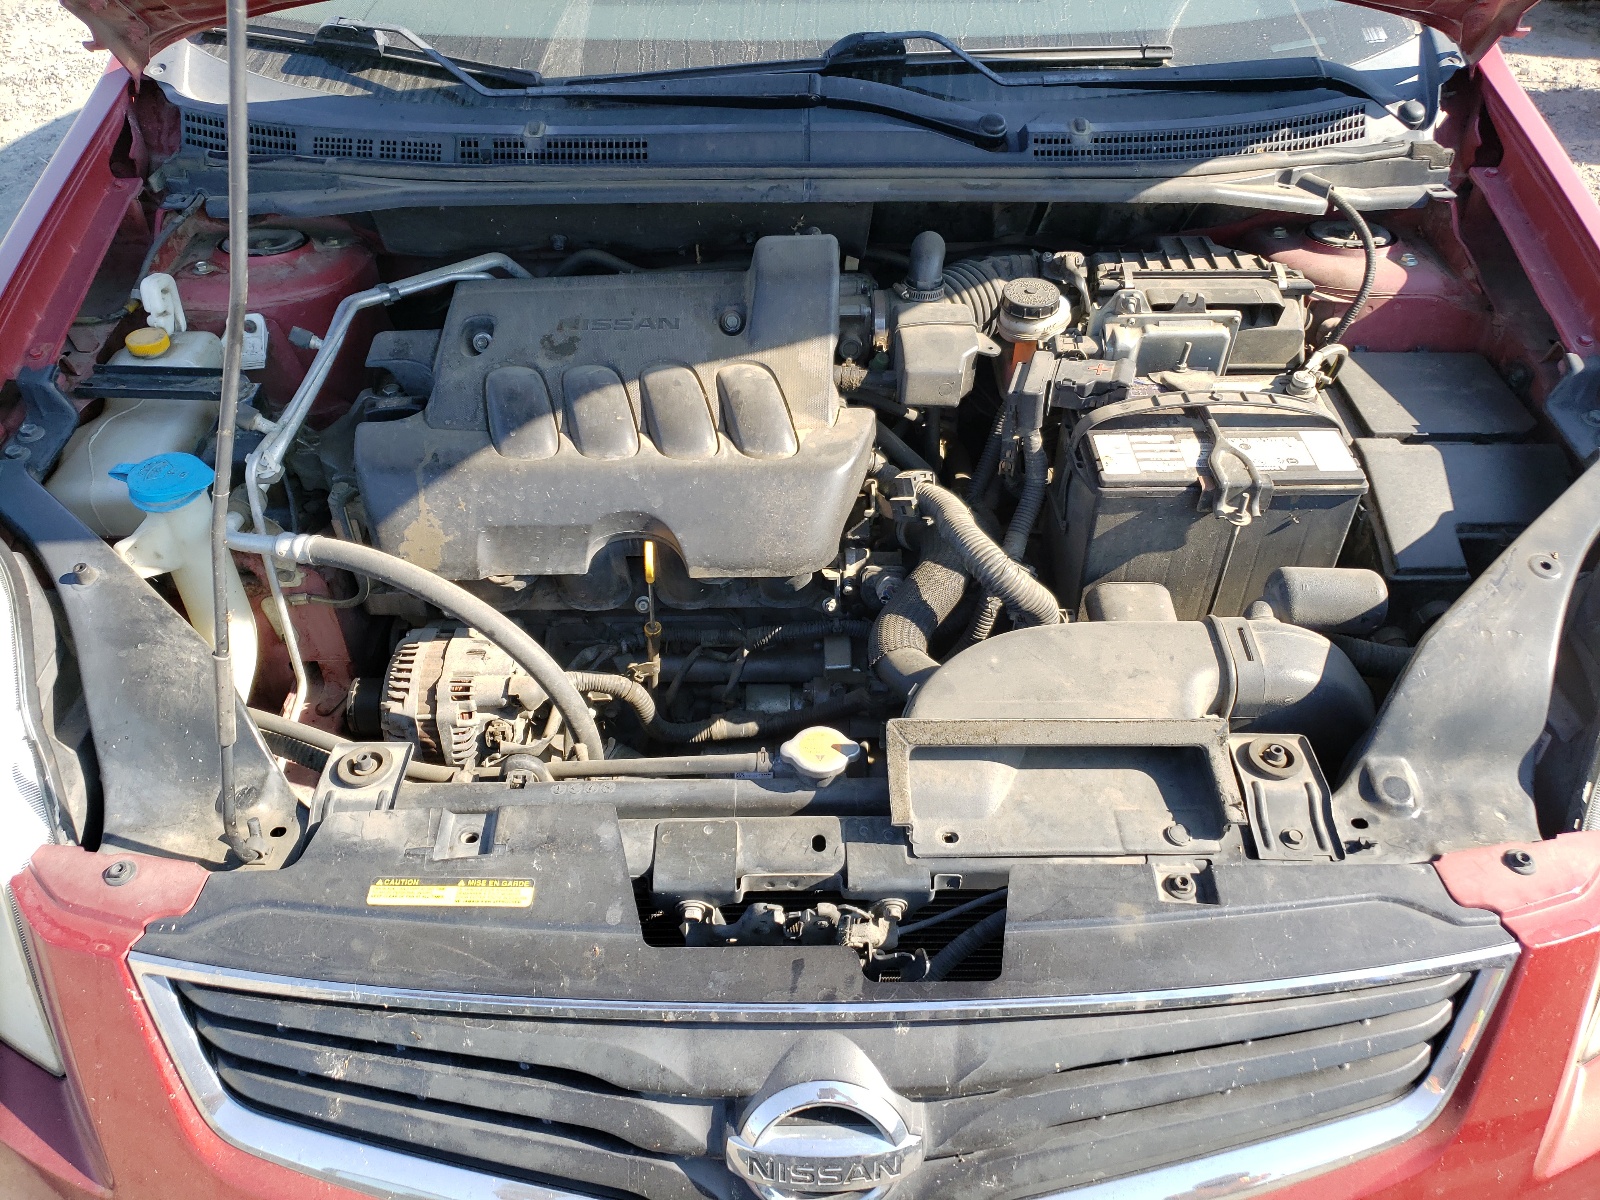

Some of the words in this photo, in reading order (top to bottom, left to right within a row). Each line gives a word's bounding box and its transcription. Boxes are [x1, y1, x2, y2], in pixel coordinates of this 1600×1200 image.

[556, 317, 681, 332] NISSAN
[384, 878, 420, 887] CAUTION
[467, 879, 488, 887] MISE
[489, 879, 500, 887] EN
[747, 1154, 901, 1187] NISSAN
